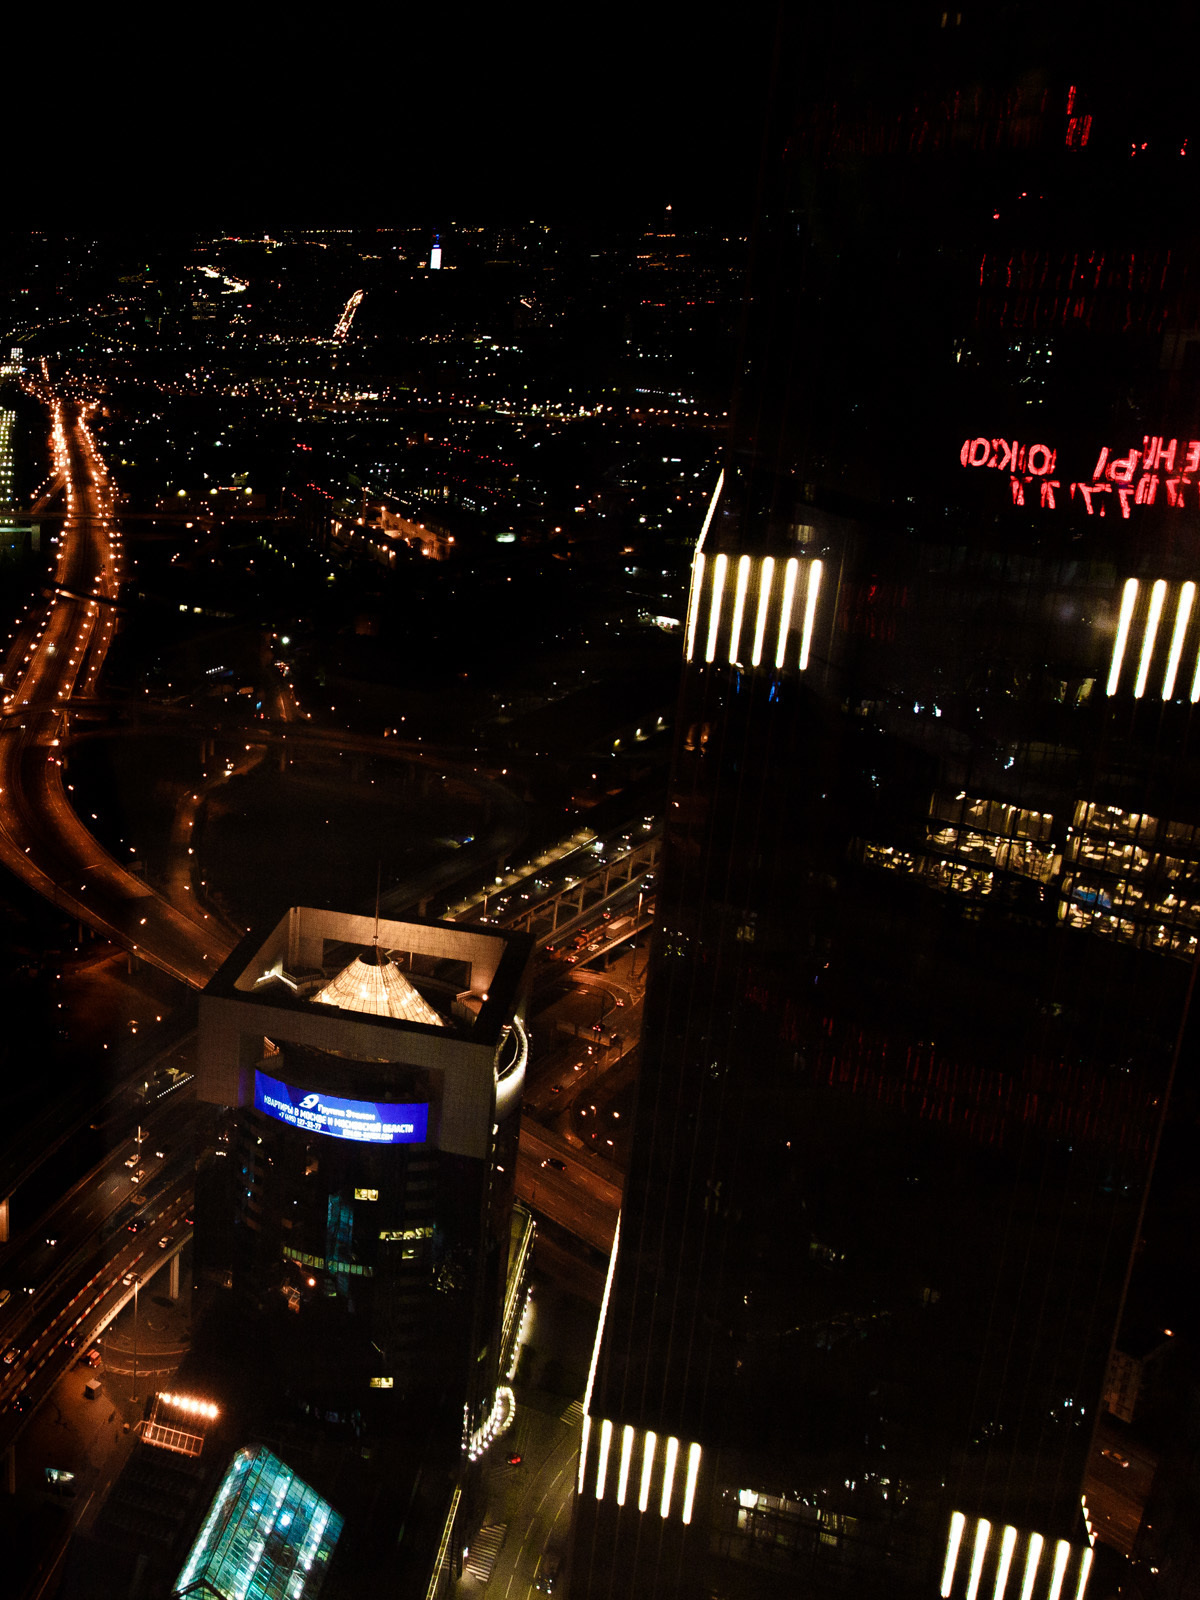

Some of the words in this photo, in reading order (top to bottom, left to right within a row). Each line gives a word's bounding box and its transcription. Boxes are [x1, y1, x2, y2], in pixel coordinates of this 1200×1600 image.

[264, 1095, 293, 1114] КВАРТИРЫ
[294, 1108, 299, 1116] В
[300, 1110, 327, 1125] МОСКВЕ
[328, 1117, 334, 1126] И
